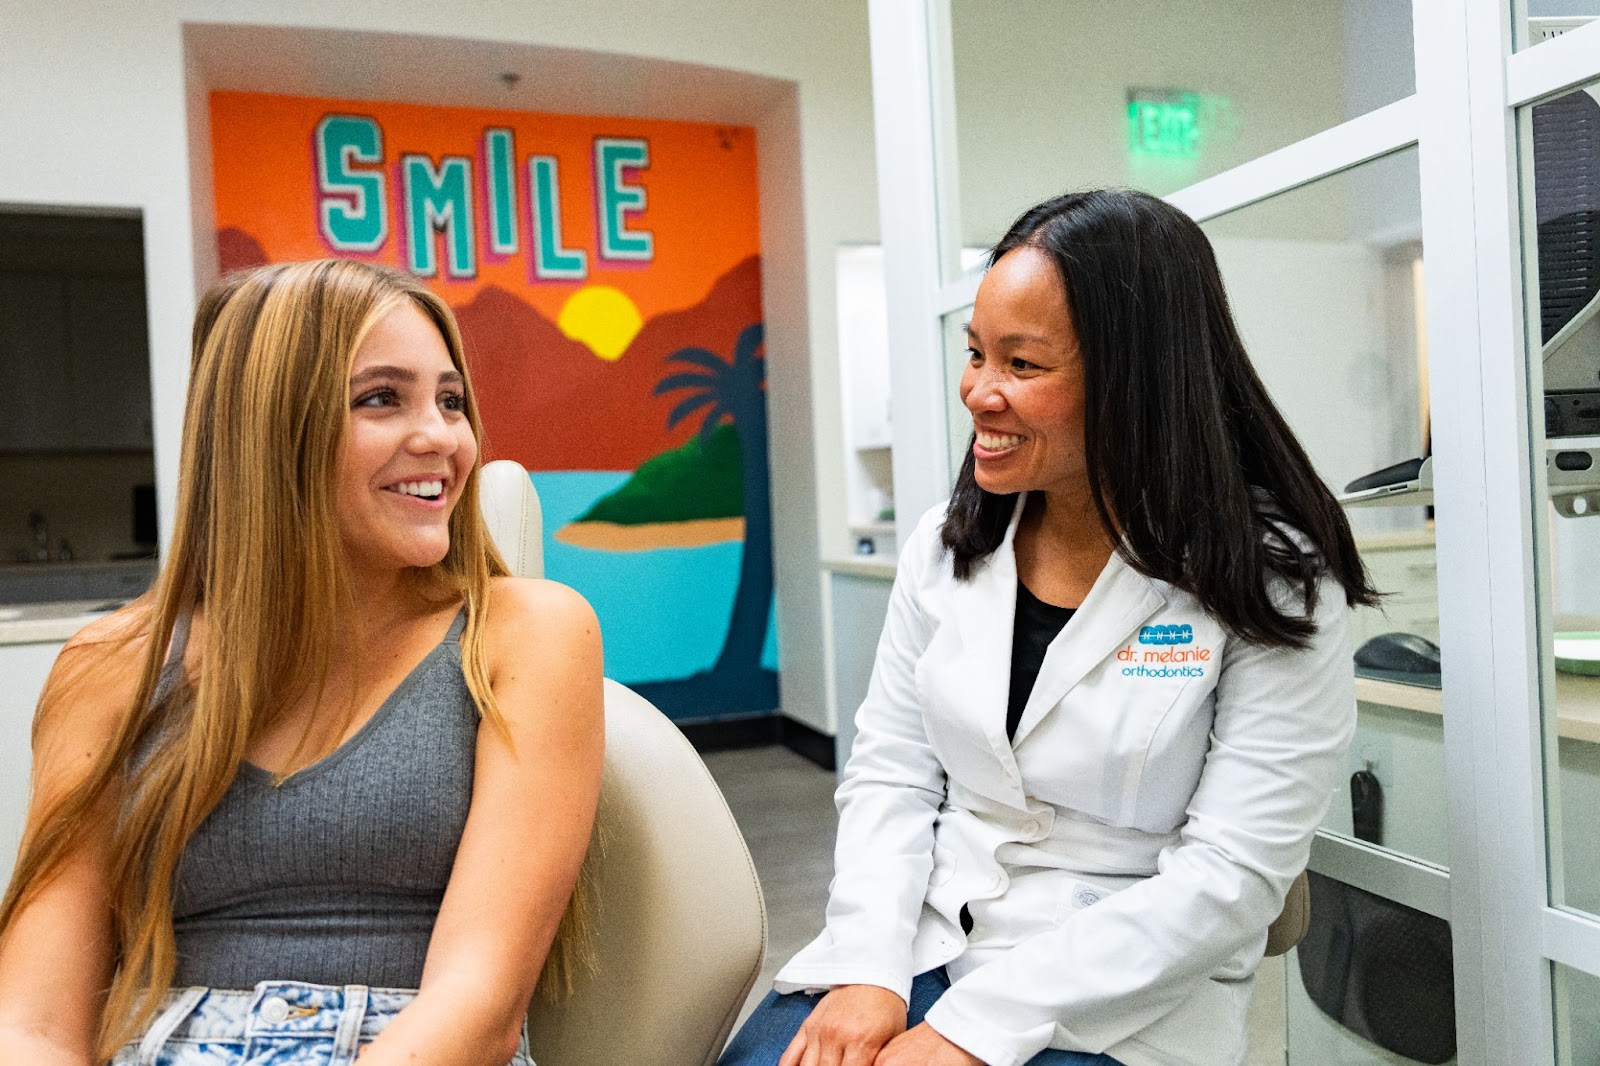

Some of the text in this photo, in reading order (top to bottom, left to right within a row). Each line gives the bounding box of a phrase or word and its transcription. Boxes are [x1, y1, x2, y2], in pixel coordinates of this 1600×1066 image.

[312, 113, 653, 281] SMILE
[1117, 645, 1211, 663] dr. melanie
[1121, 664, 1204, 678] orthodontics
